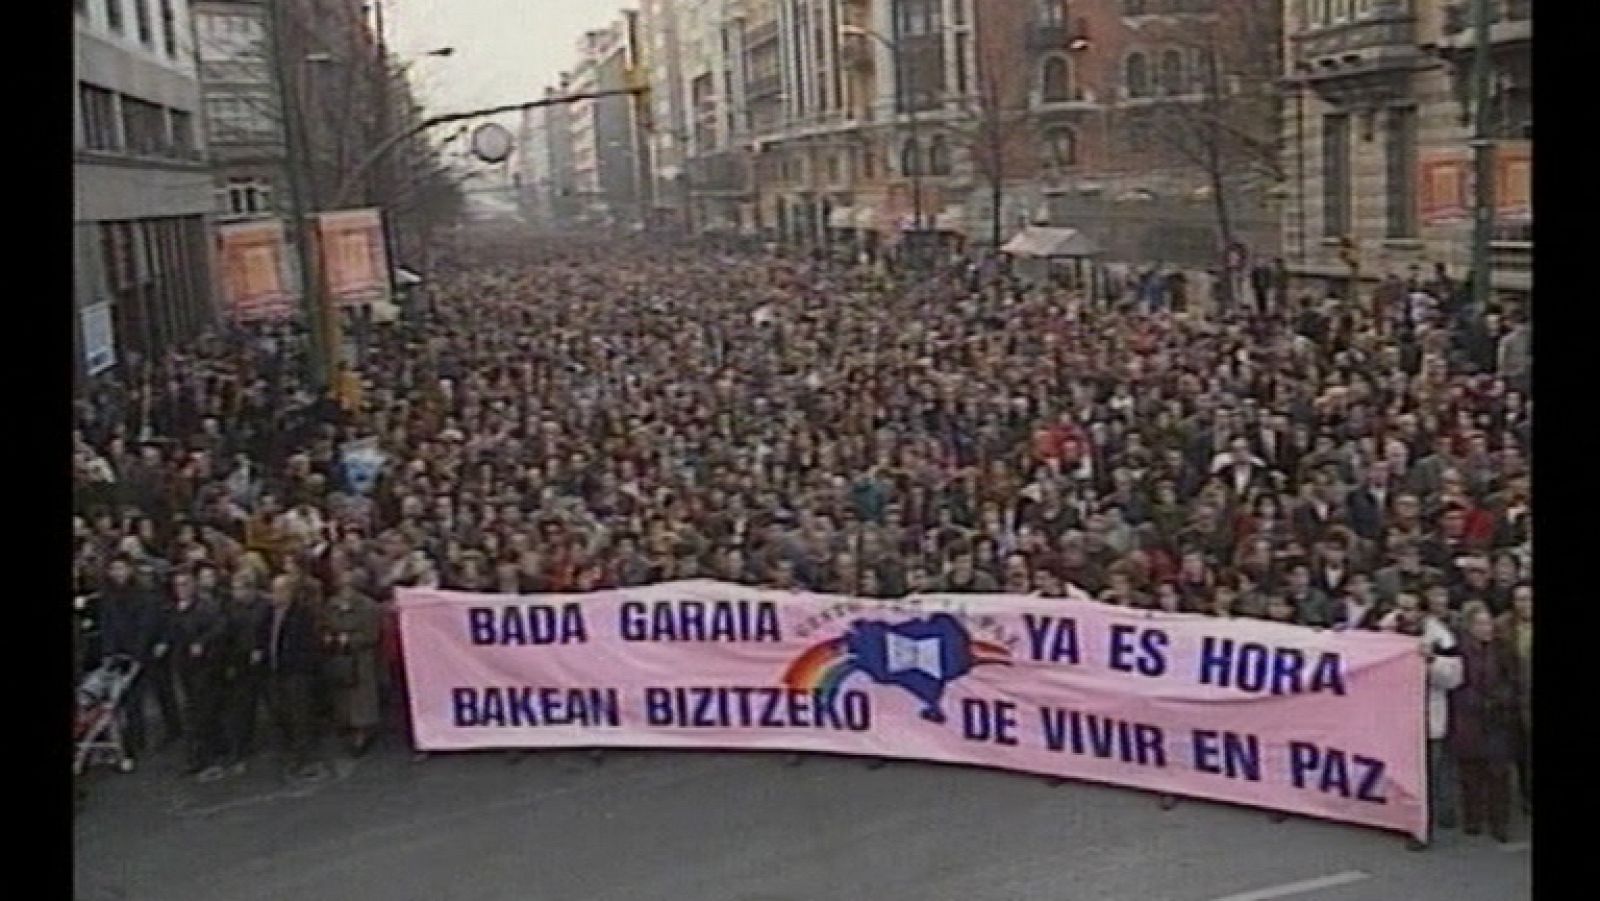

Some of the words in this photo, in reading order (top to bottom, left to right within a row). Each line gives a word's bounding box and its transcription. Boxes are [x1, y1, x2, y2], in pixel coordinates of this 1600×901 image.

[469, 604, 586, 645] BADA
[620, 600, 781, 644] GARAIA
[1023, 615, 1080, 664] YA
[1109, 623, 1168, 676] ES
[1199, 635, 1346, 695] HORA
[452, 685, 620, 728] BAKEAN
[646, 685, 870, 732] BIZITZEKO
[962, 699, 1018, 745] DE
[1040, 706, 1166, 767] VIVIR
[1191, 728, 1261, 782] EN
[1288, 741, 1388, 805] PAZ
